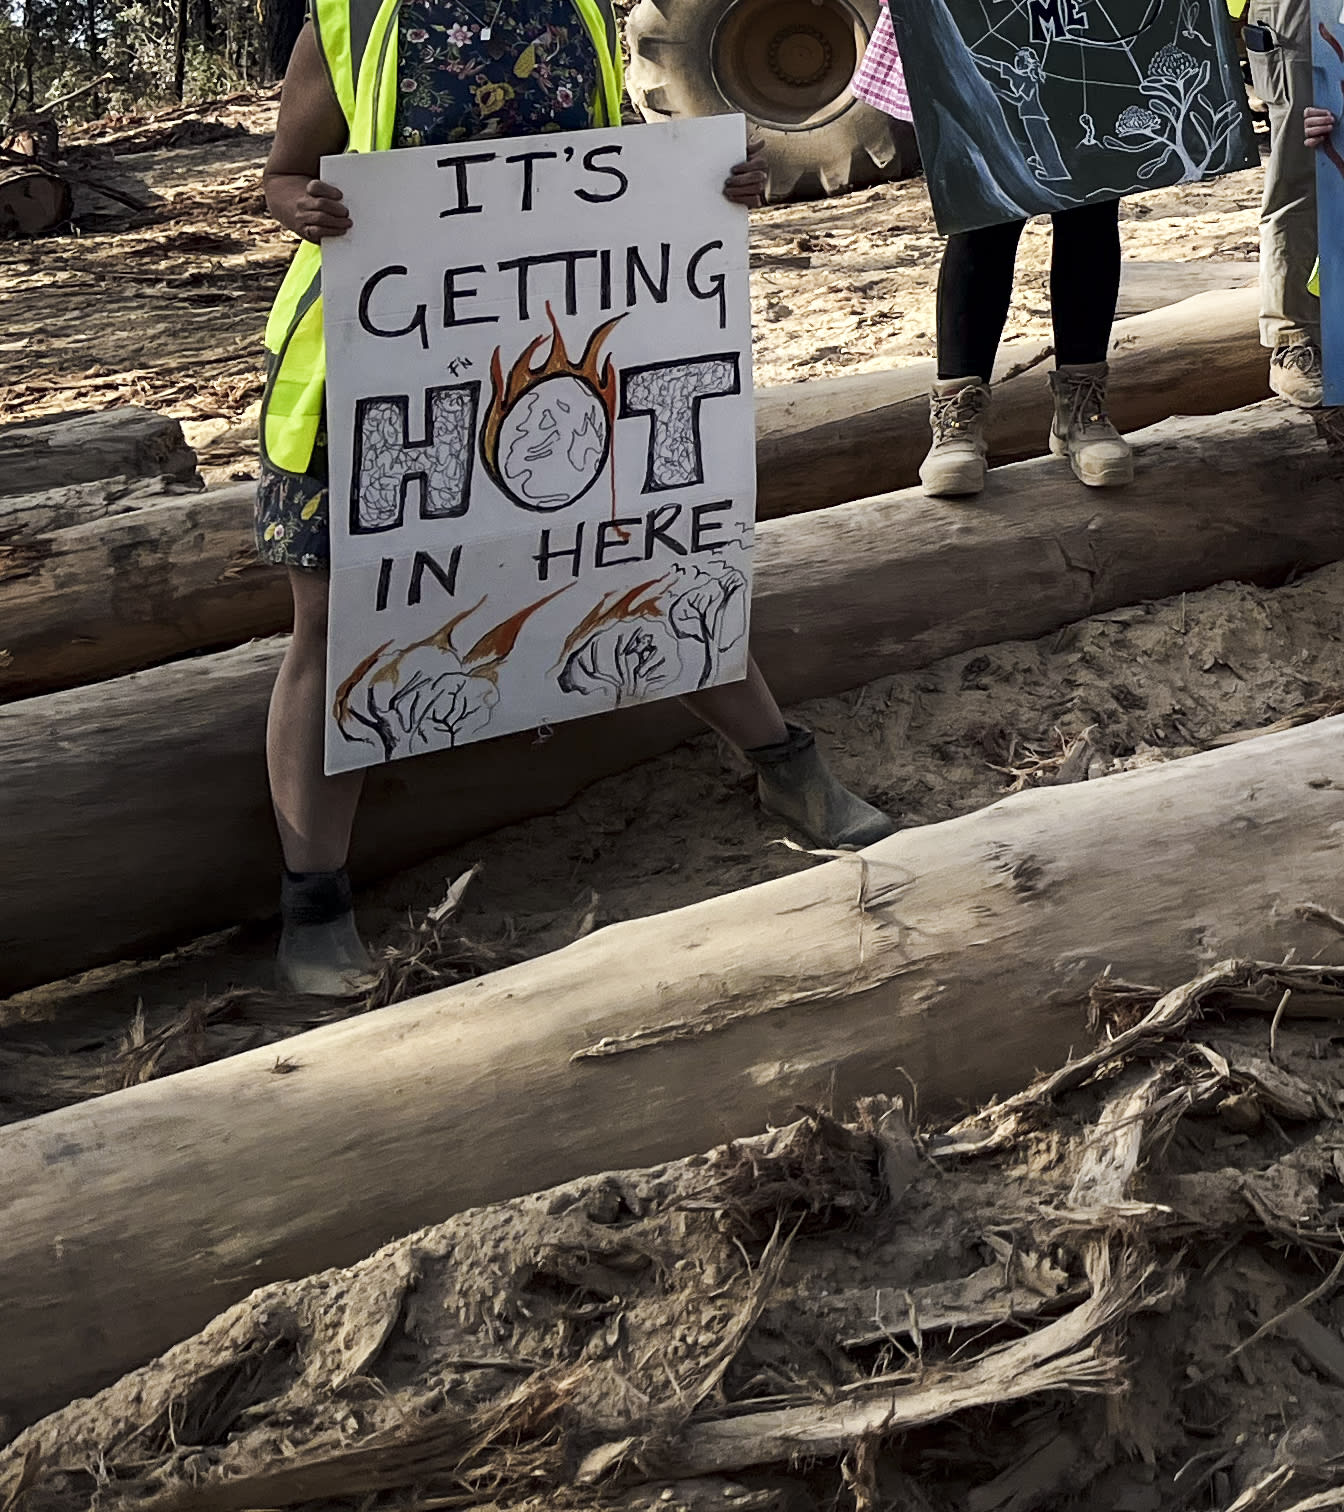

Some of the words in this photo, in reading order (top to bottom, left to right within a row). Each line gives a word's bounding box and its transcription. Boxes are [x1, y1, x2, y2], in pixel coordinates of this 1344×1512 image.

[437, 145, 628, 218] IT'S
[358, 240, 725, 349] GETTING
[349, 351, 743, 535] HOT
[376, 545, 462, 611] IN
[532, 500, 733, 581] HERE
